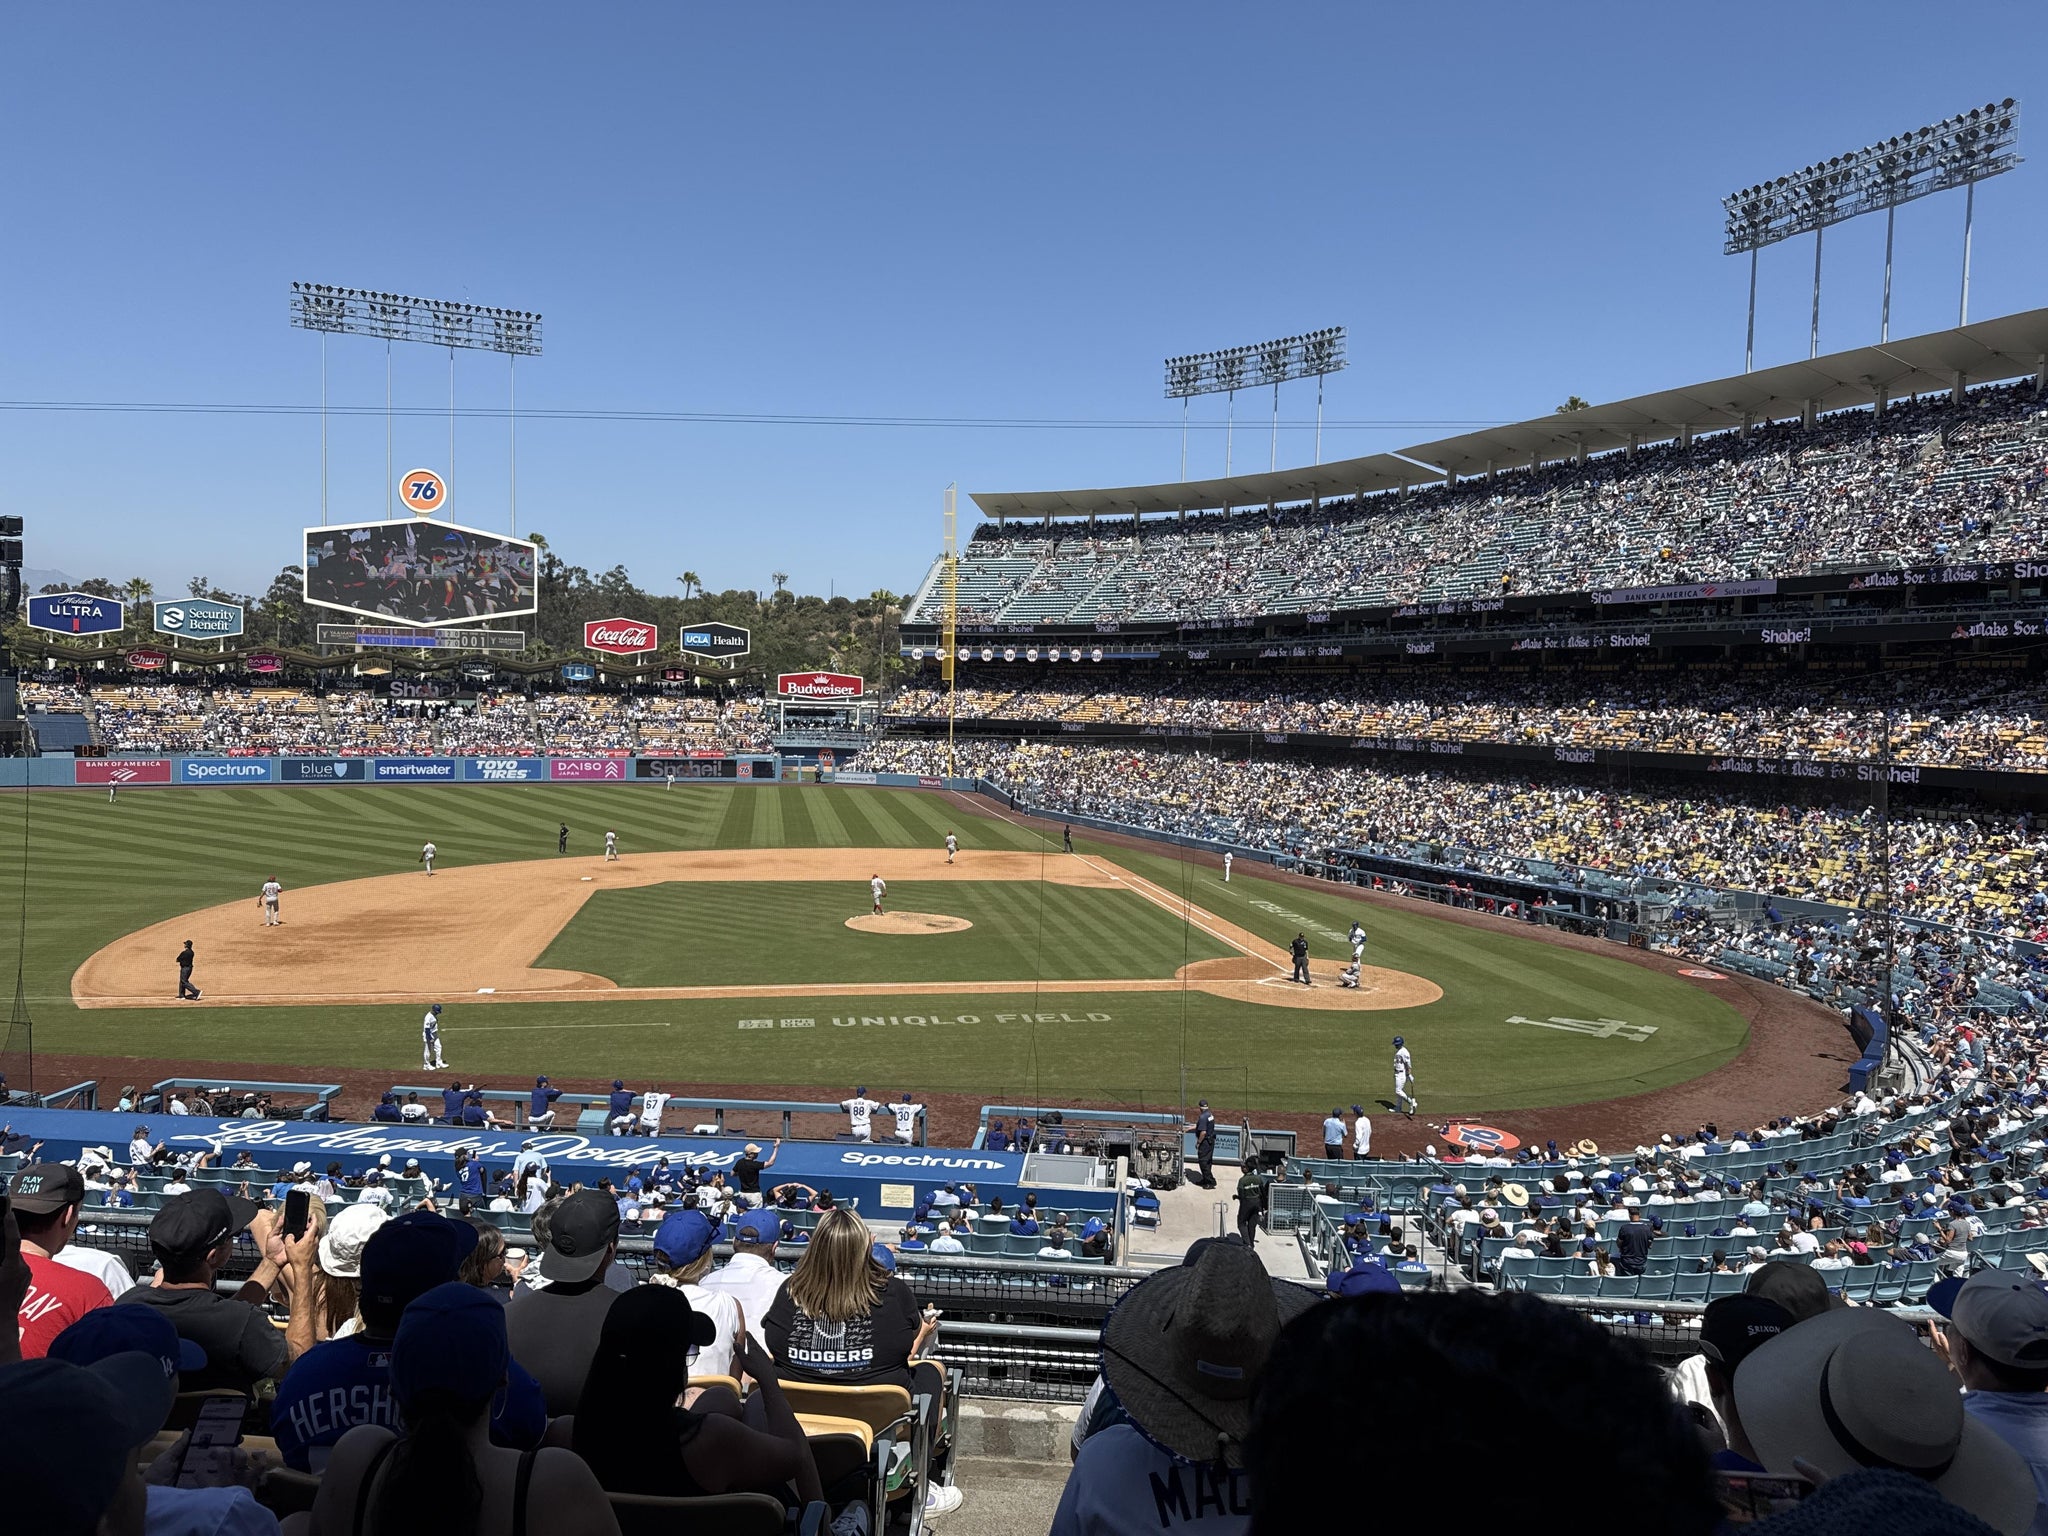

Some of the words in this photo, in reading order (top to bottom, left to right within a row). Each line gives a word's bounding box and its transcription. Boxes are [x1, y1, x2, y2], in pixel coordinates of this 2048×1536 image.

[409, 481, 437, 500] 76
[1625, 593, 1646, 601] BANK
[1649, 592, 1659, 600] OF
[1660, 590, 1698, 599] AMERICA
[1724, 587, 1741, 595] Suite
[1742, 586, 1761, 595] Level
[50, 604, 102, 617] ULTRA
[189, 608, 235, 622] Security
[189, 619, 229, 631] Benefit
[591, 626, 649, 647] Coca-Cola
[686, 635, 709, 644] UCLA
[713, 635, 744, 646] Health
[1610, 633, 1650, 647] Shohei!
[129, 653, 165, 665] Churu
[787, 682, 854, 696] Budweiser
[821, 752, 832, 760] 76
[301, 763, 332, 774] blue
[379, 764, 451, 775] smartwater
[476, 761, 518, 769] TOYO
[558, 763, 602, 771] DAISO
[650, 760, 722, 777] Shohei!
[740, 766, 749, 774] 76
[188, 764, 261, 779] Spectrum
[483, 770, 527, 779] TIRES
[1857, 765, 1920, 783] Shohei!
[831, 1014, 981, 1028] UNIQLO
[995, 1011, 1112, 1024] FIELD
[646, 1099, 658, 1110] 67
[853, 1106, 865, 1116] 88
[898, 1111, 909, 1121] 30
[170, 1121, 289, 1146] Los
[271, 1126, 507, 1156] Angeles
[492, 1134, 743, 1168] Dodgers
[840, 1151, 993, 1170] Spectrum
[22, 1176, 44, 1184] PLAY
[1747, 1325, 1781, 1336] SRIXON
[788, 1346, 873, 1362] DODGERS
[290, 1385, 401, 1444] HERSH
